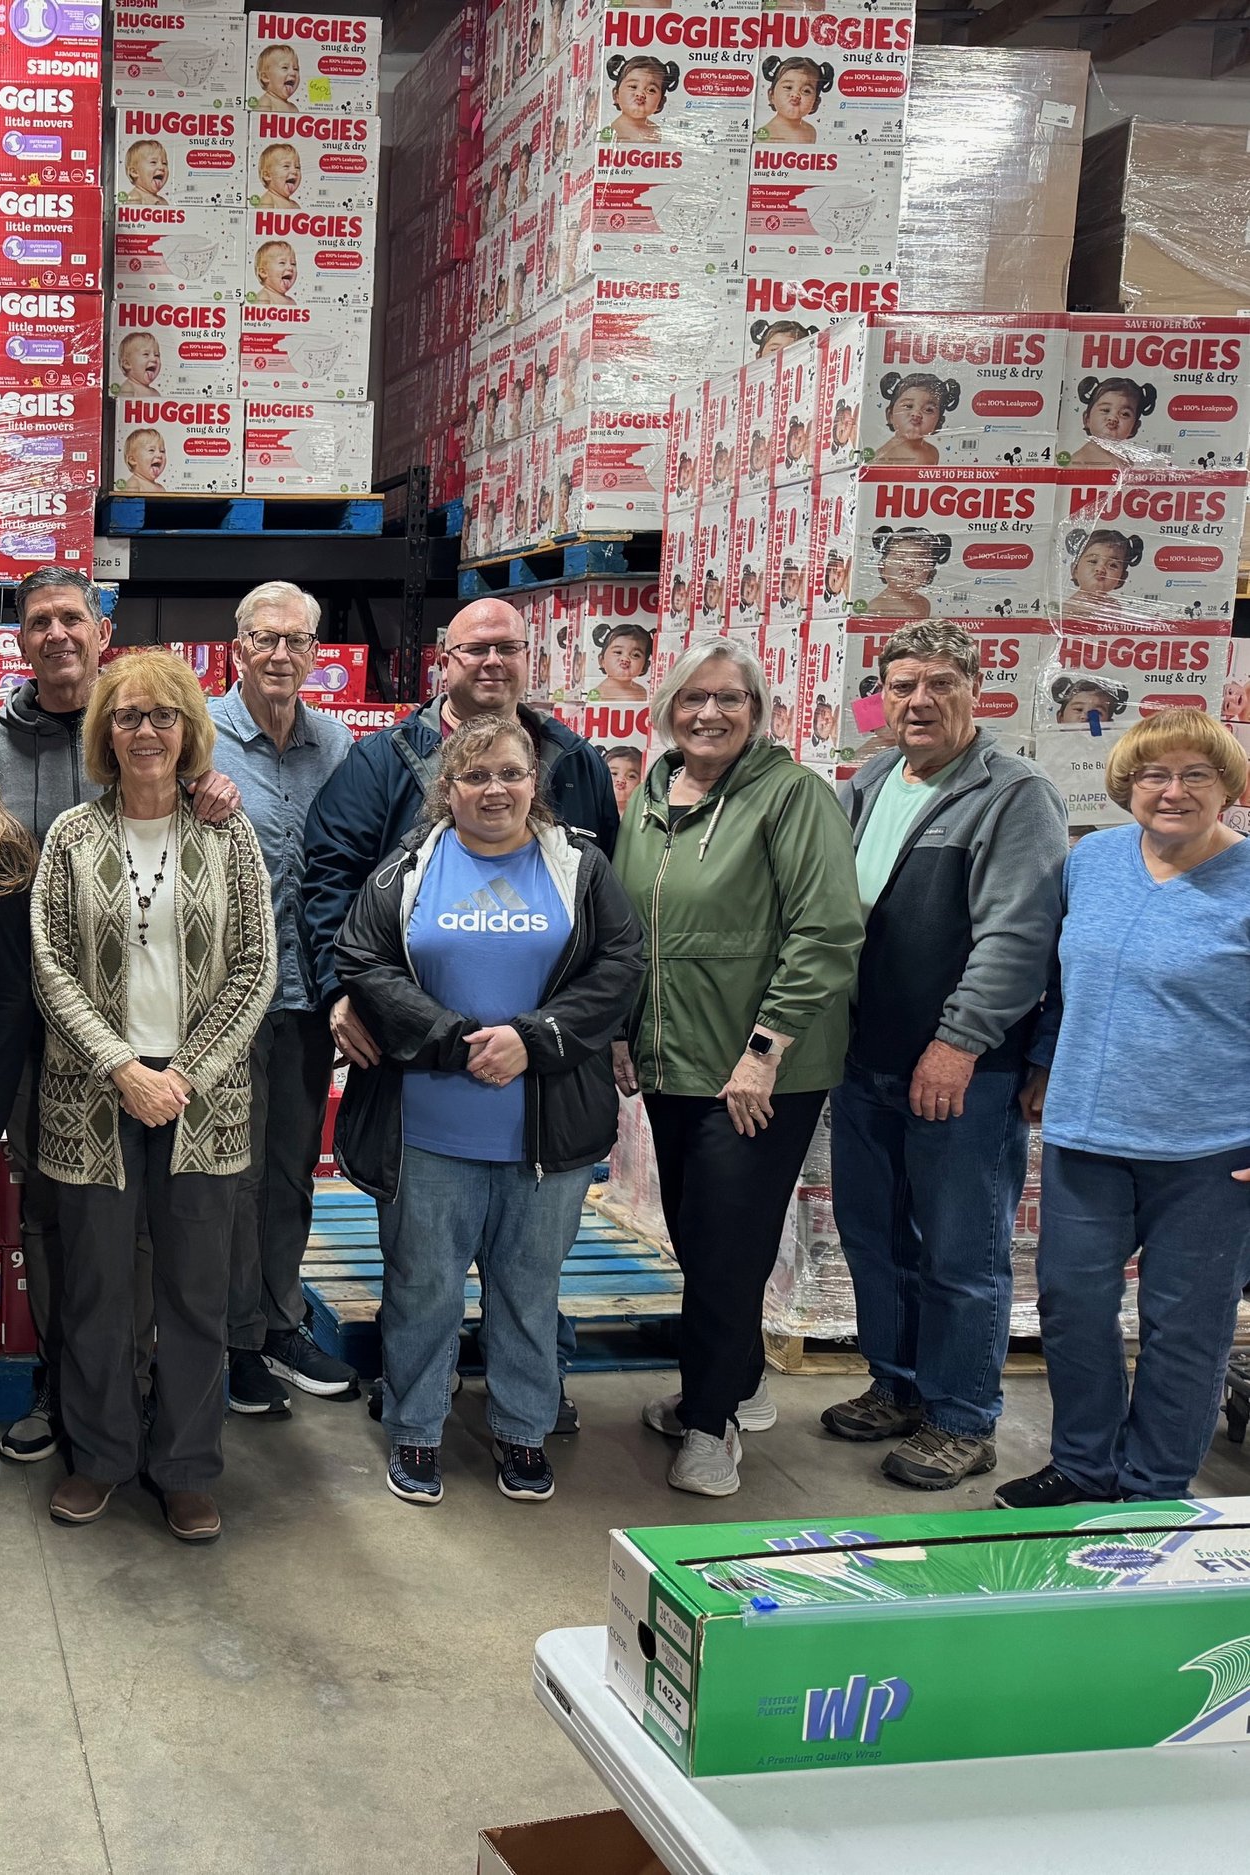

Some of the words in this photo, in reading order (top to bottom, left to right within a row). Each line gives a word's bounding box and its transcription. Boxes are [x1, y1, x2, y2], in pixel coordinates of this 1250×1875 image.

[117, 12, 184, 30] HUGGIES
[258, 14, 367, 43] HUGGIES
[604, 11, 759, 49] HUGGIES
[760, 12, 912, 50] HUGGIES
[321, 43, 340, 53] snug
[351, 44, 366, 54] dry
[688, 52, 718, 64] snug
[720, 51, 730, 62] &
[733, 51, 754, 65] dry
[26, 59, 98, 78] HUGGIES
[366, 101, 372, 110] 5
[125, 111, 234, 137] HUGGIES
[259, 113, 367, 141] HUGGIES
[741, 118, 749, 130] 4
[895, 119, 902, 130] 4
[189, 137, 209, 147] snug
[219, 137, 234, 148] dry
[598, 149, 682, 169] HUGGIES
[754, 151, 837, 171] HUGGIES
[85, 170, 94, 183] 5
[236, 192, 242, 202] 5
[118, 208, 185, 224] HUGGIES
[255, 212, 362, 238] HUGGIES
[885, 262, 892, 271] 4
[597, 280, 680, 299] HUGGIES
[747, 278, 899, 312] HUGGIES
[119, 303, 226, 328] HUGGIES
[244, 306, 310, 322] HUGGIES
[1125, 320, 1148, 329] SAVE
[1164, 320, 1179, 328] PER
[882, 330, 1045, 365] HUGGIES
[1082, 334, 1240, 370] HUGGIES
[977, 368, 1007, 379] snug
[1011, 367, 1022, 377] &
[1025, 367, 1043, 380] dry
[227, 384, 232, 393] 5
[124, 401, 231, 425] HUGGIES
[249, 403, 314, 418] HUGGIES
[1041, 447, 1050, 460] 4
[918, 471, 941, 479] SAVE
[957, 471, 973, 479] PER
[875, 485, 1035, 519] HUGGIES
[1070, 488, 1226, 522] HUGGIES
[115, 557, 121, 567] 5
[317, 649, 340, 659] GGIES
[1061, 638, 1209, 671] HUGGIES
[1144, 673, 1172, 684] snug
[1175, 673, 1185, 682] &
[1187, 672, 1206, 685] dry
[1071, 762, 1080, 770] To
[1083, 762, 1093, 770] Be
[1096, 761, 1106, 770] Bu
[1069, 793, 1106, 803] DIAPER
[1069, 803, 1097, 812] BANK
[437, 909, 549, 932] adidas
[611, 1559, 626, 1581] SIZE
[611, 1591, 636, 1626] METRIC
[609, 1625, 628, 1653] CODE
[657, 1679, 682, 1714] 142-Z
[802, 1674, 913, 1745] WP
[757, 1757, 765, 1766] A
[767, 1754, 813, 1765] Premium
[816, 1751, 852, 1763] Quality
[855, 1749, 882, 1761] Wrap
